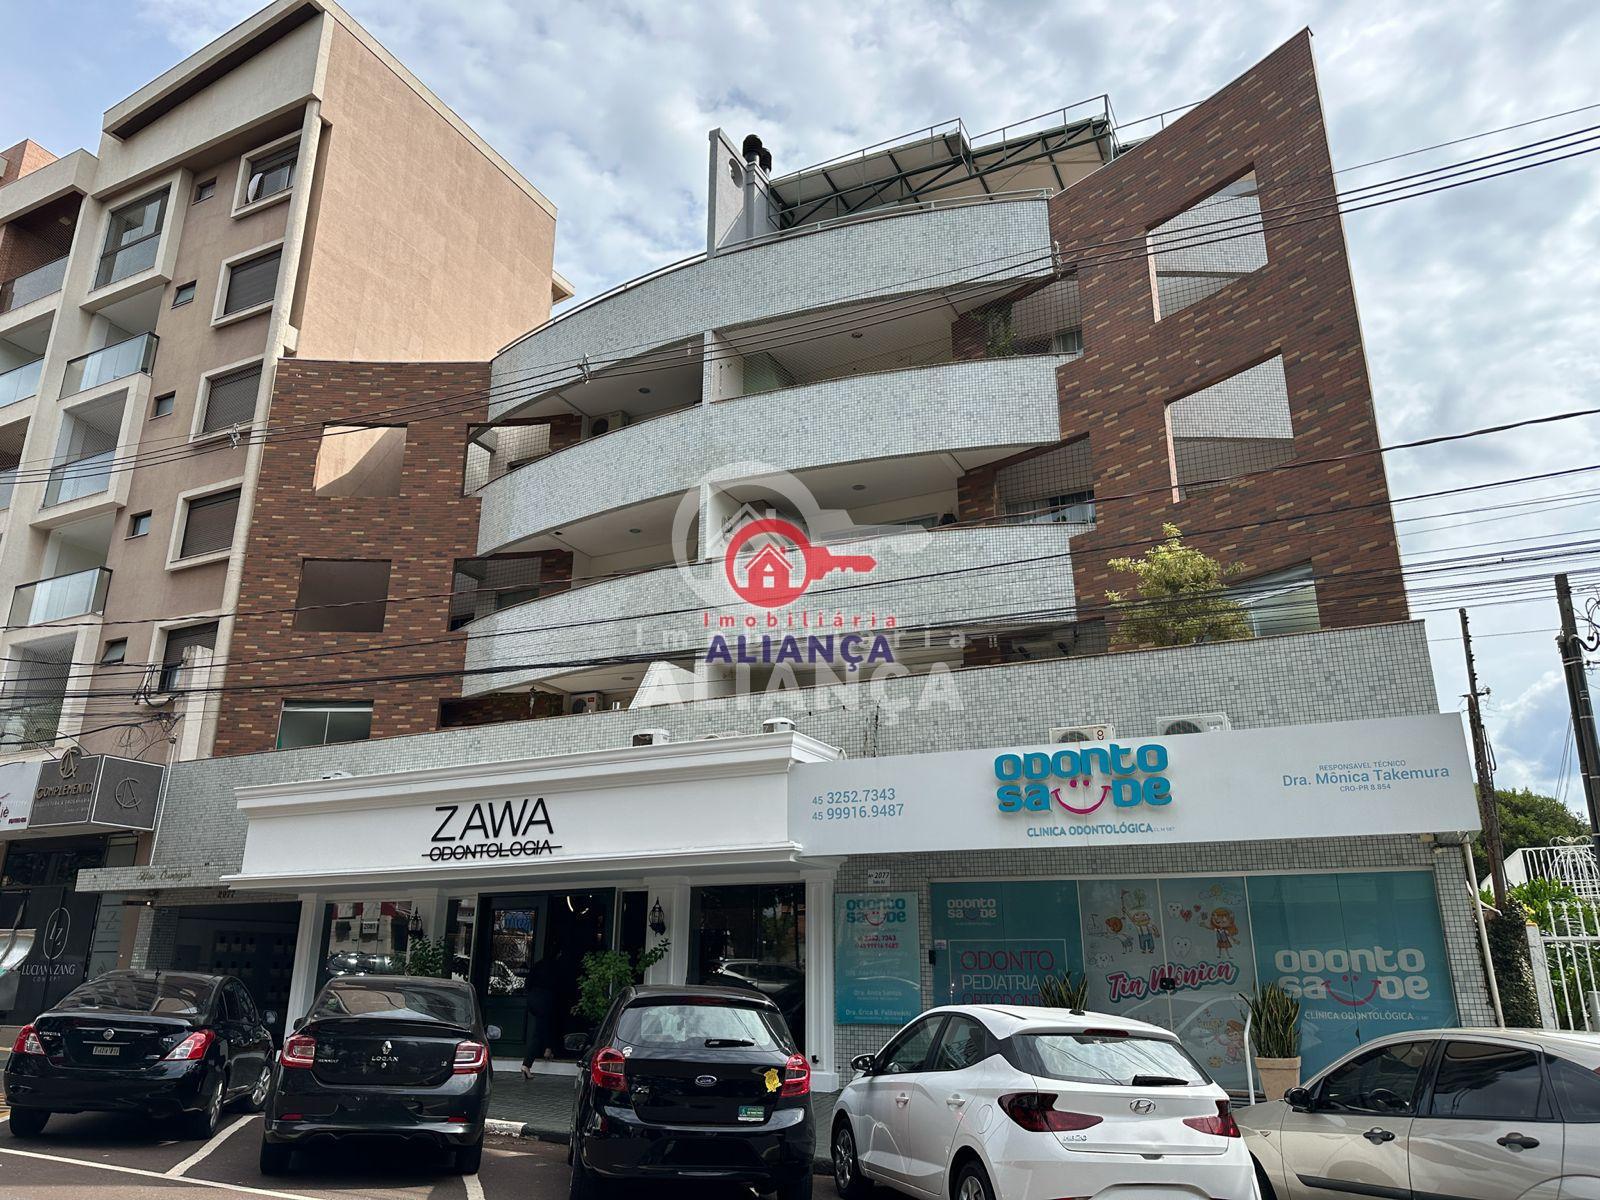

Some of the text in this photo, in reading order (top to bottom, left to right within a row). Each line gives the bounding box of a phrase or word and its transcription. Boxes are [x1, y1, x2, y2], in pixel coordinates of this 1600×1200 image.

[1373, 759, 1406, 768] TÉCNICO
[1282, 767, 1450, 787] Dra. Mônica Takemura
[36, 783, 93, 800] COMPLEMENTO
[812, 788, 896, 805] 45 3252.7343
[1340, 784, 1370, 792] CRO-PR
[431, 797, 554, 842] ZAWA
[812, 803, 904, 821] 45 99916.9487
[1068, 821, 1154, 836] ODONTOLÓGICA
[429, 839, 553, 862] ODONTOLOGIA
[874, 871, 889, 879] 2077
[960, 950, 1055, 971] ODONTO
[54, 963, 76, 976] ZANG
[962, 974, 1041, 991] PEDIATRIA
[1340, 1009, 1415, 1021] ODONTOLÓGICA
